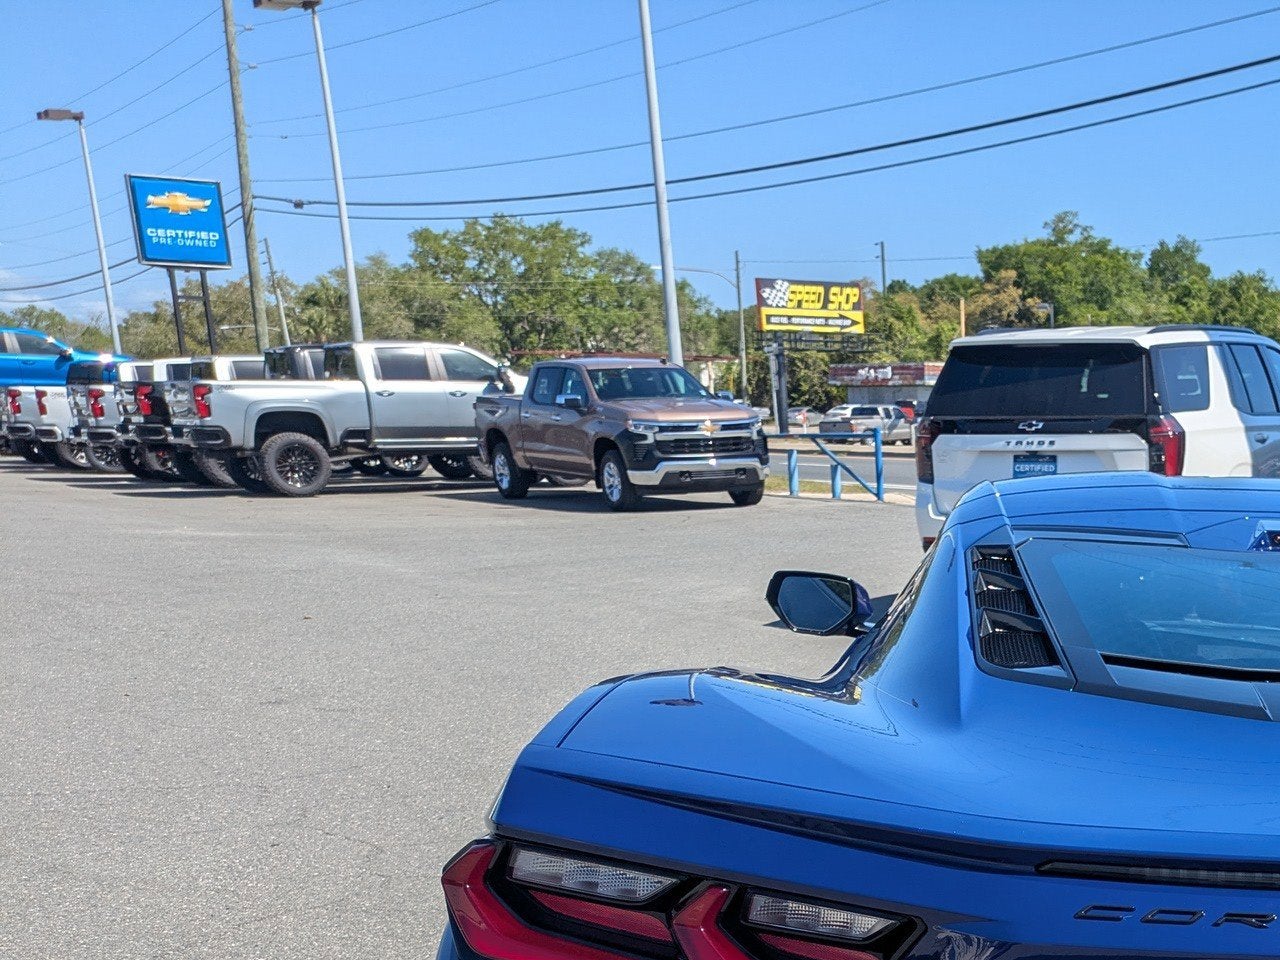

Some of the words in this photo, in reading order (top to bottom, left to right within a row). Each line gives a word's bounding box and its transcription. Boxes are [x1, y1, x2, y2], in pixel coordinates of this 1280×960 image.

[147, 228, 219, 240] CERTIFIED
[787, 284, 825, 309] SPEED
[828, 285, 860, 310] SHOP
[1014, 463, 1056, 473] CERTIFIED
